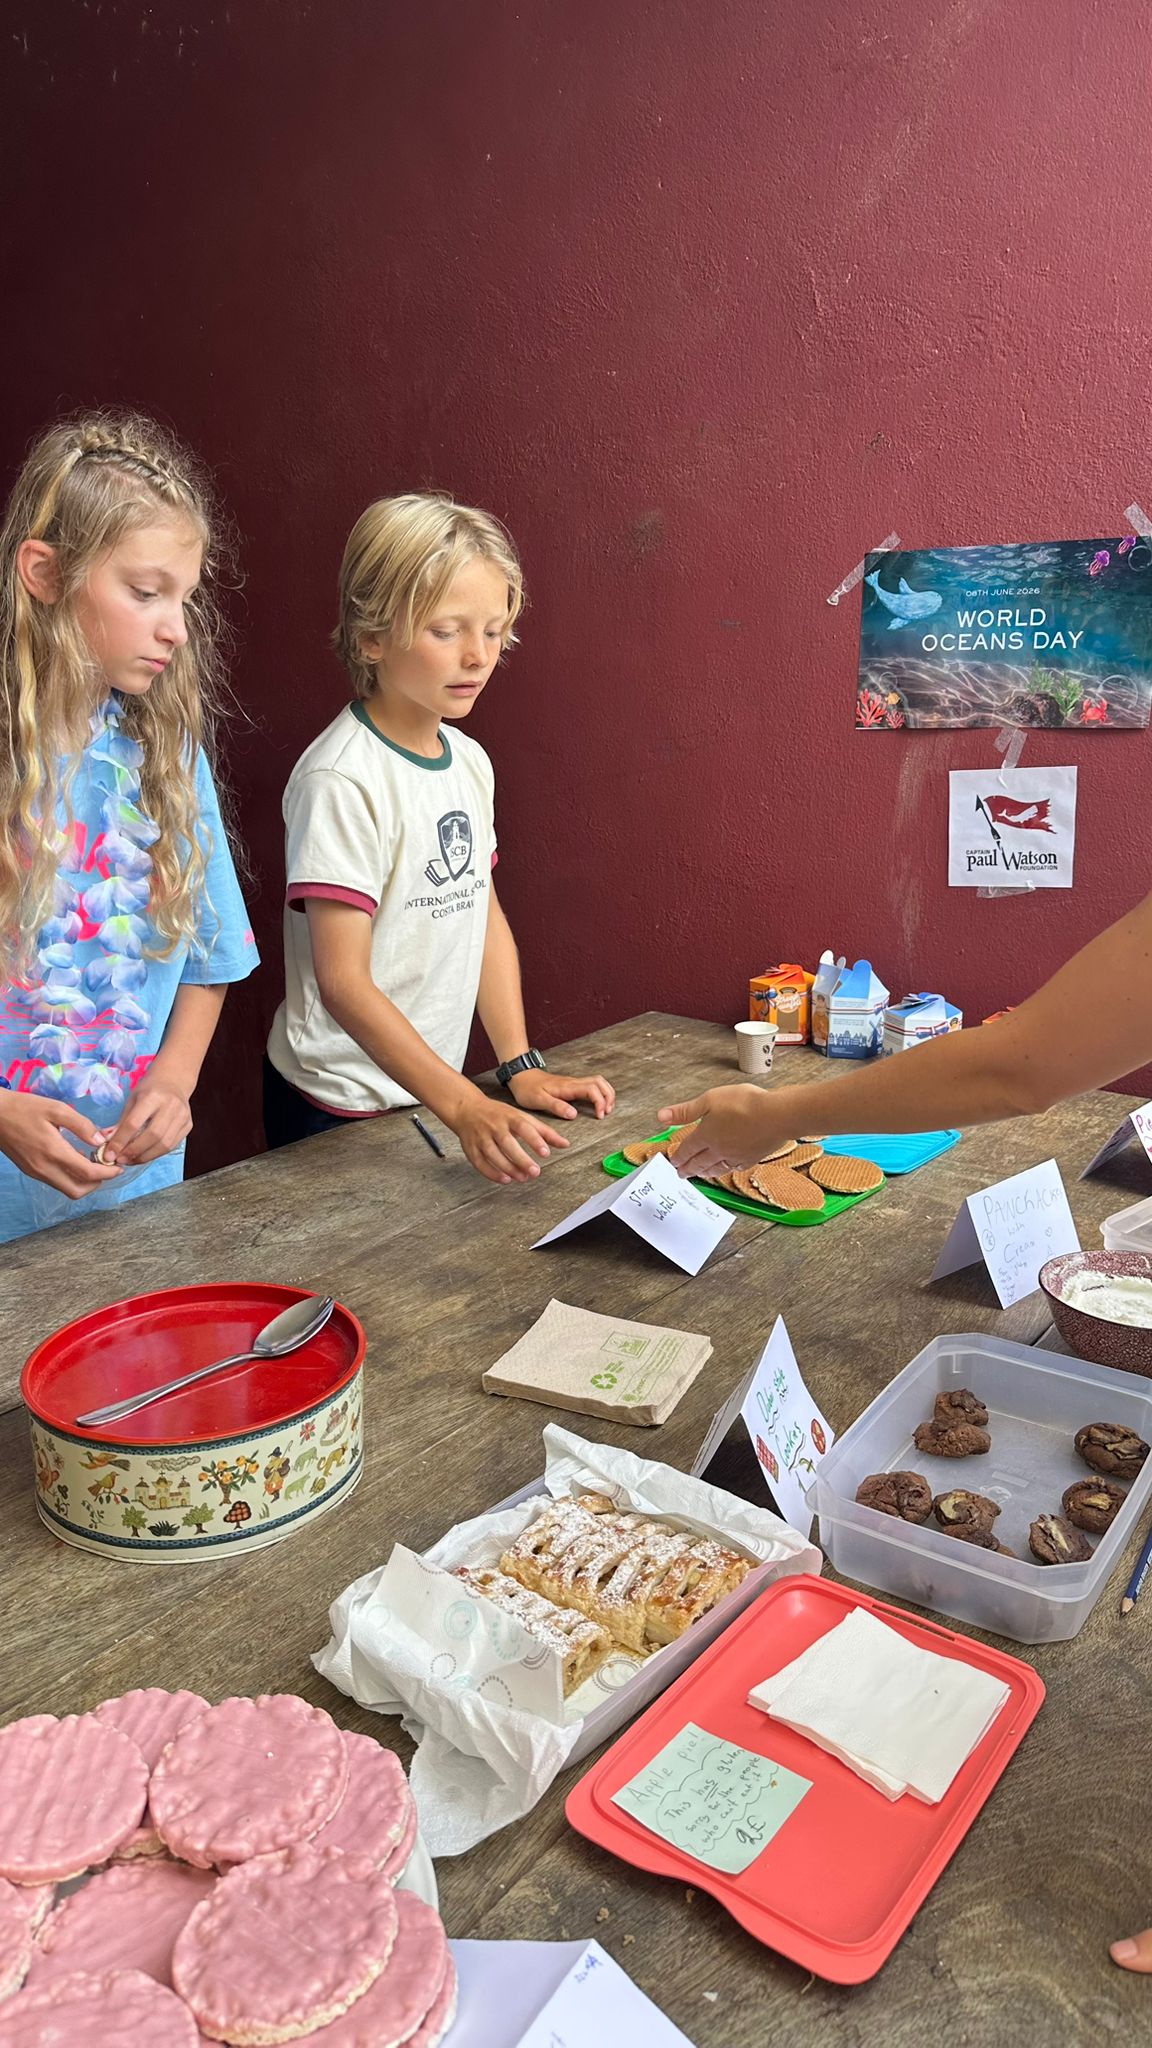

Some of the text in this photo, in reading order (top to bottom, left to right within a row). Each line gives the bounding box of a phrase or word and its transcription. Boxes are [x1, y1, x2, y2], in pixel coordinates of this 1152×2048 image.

[990, 588, 1014, 596] JUNE
[1016, 587, 1041, 595] 2026
[957, 608, 1046, 628] WORLD
[921, 630, 1084, 652] OCEANS DAY
[450, 845, 467, 858] SCB
[1001, 847, 1058, 871] Watson
[431, 903, 455, 919] COSTA
[626, 1767, 673, 1802] Apple
[663, 1801, 691, 1818] This
[690, 1779, 715, 1796] has
[702, 1825, 719, 1843] who
